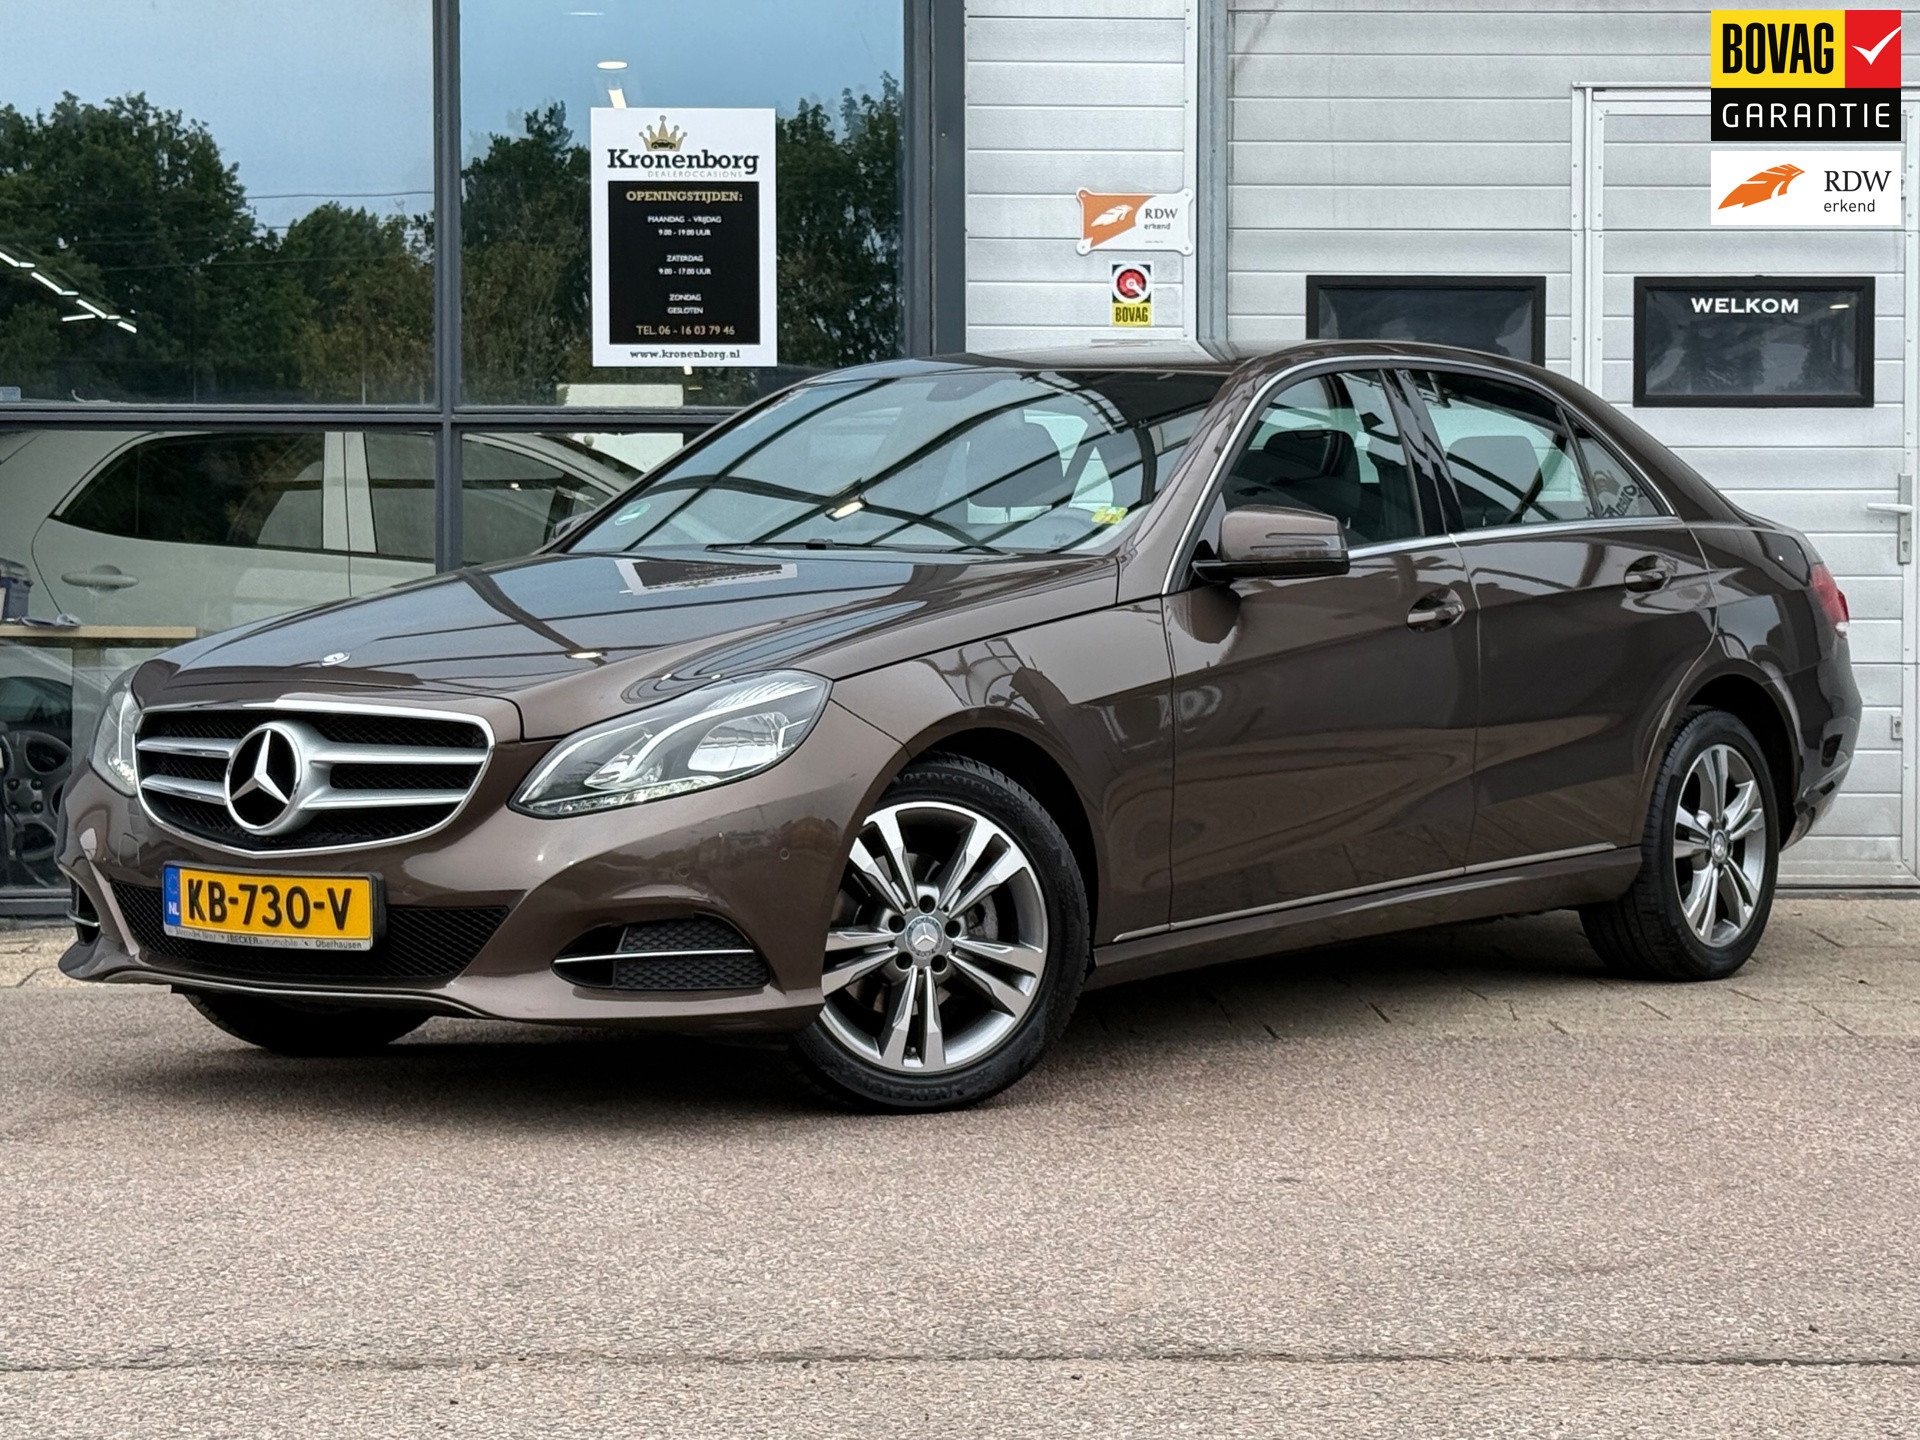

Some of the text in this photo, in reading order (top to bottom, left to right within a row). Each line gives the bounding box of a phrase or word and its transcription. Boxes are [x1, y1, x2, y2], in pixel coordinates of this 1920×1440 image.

[607, 148, 760, 175] Kronenborg
[647, 170, 743, 178] DEALEROCCASIONS
[625, 190, 743, 204] OPENINGSTIJDEN:
[647, 215, 685, 223] MAANDAG
[692, 215, 722, 225] VRIJDAG
[1144, 208, 1178, 219] RDW
[1691, 298, 1799, 313] WELKOM
[1115, 307, 1149, 322] BOVAG
[658, 325, 671, 335] 06
[681, 325, 692, 335] 16
[694, 325, 707, 335] 03
[709, 325, 721, 335] 79
[723, 325, 736, 335] 46
[630, 350, 740, 360] www.kronenborg.nl
[168, 902, 180, 916] NL
[188, 878, 352, 931] KB-730-V
